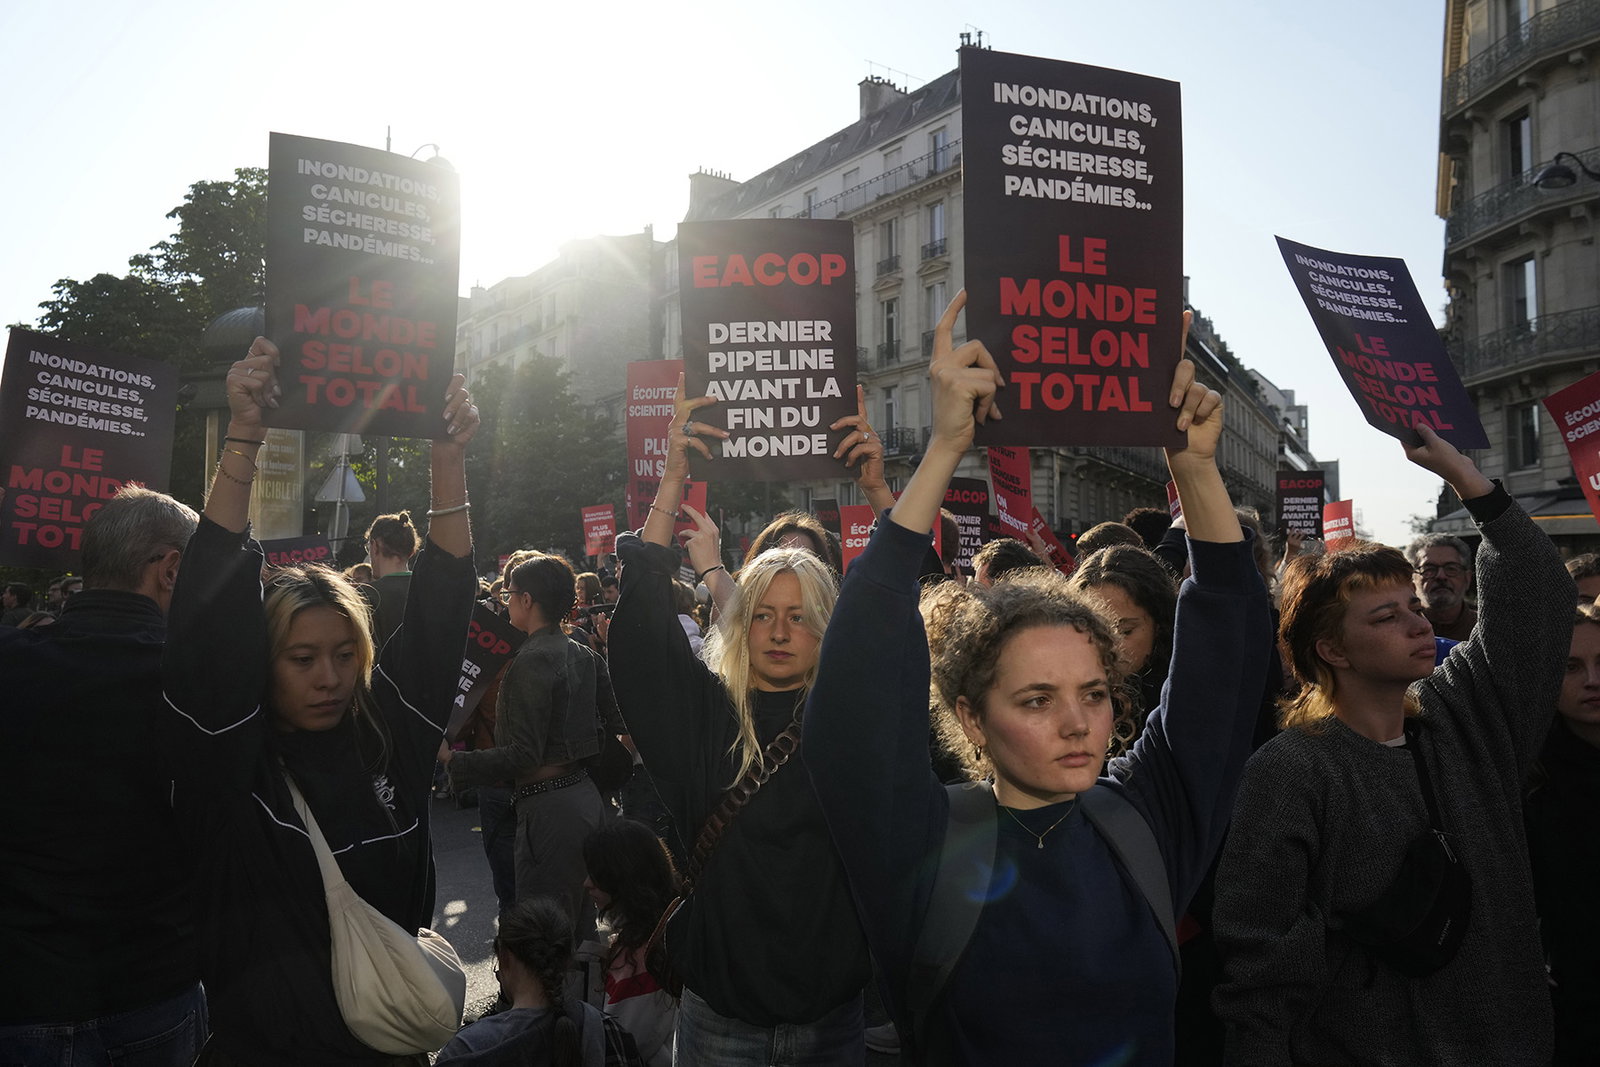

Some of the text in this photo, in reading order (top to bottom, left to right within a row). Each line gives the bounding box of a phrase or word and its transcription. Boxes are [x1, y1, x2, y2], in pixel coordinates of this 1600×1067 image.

[994, 82, 1157, 127] INONDATIONS,
[1009, 115, 1146, 154] CANICULES,
[1002, 140, 1154, 185] SÉCHERESSE,
[298, 159, 440, 204] INONDATIONS,
[1005, 175, 1152, 210] PANDÉMIES...
[311, 184, 431, 222] CANICULES,
[302, 203, 436, 245] SÉCHERESSE,
[304, 228, 433, 264] PANDÉMIES...
[1059, 234, 1107, 276] LE
[693, 252, 846, 288] EACOP
[1295, 253, 1394, 282] INONDATIONS,
[1308, 271, 1391, 296] CANICULES,
[348, 276, 394, 309] LE
[1000, 277, 1157, 325] MONDE
[1310, 283, 1403, 310] SÉCHERESSE,
[294, 303, 437, 348] MONDE
[1317, 298, 1407, 323] PANDÉMIES...
[709, 320, 832, 344] DERNIER
[1011, 324, 1149, 368] SELON
[1355, 332, 1391, 357] LE
[29, 350, 156, 390] INONDATIONS,
[301, 340, 429, 380] SELON
[708, 349, 835, 373] PIPELINE
[1336, 345, 1439, 382] MONDE
[28, 386, 148, 422] SÉCHERESSE,
[37, 371, 144, 405] CANICULES,
[299, 375, 426, 413] TOTAL
[705, 377, 842, 401] AVANT LA
[1011, 372, 1152, 412] TOTAL
[1353, 372, 1443, 406] SELON
[26, 405, 145, 437] PANDÉMIES...
[629, 405, 675, 416] SCIENTIFI
[727, 406, 820, 429] FIN DU
[1364, 395, 1454, 431] TOTAL
[1565, 400, 1600, 427] ÉCOU
[60, 445, 104, 471] LE
[644, 438, 669, 455] PLU
[722, 434, 827, 458] MONDE
[635, 460, 653, 476] UN
[1280, 480, 1323, 489] EACOP
[945, 488, 988, 504] EACOP
[12, 522, 84, 550] TOT
[952, 514, 981, 525] ERNIER
[268, 545, 329, 565] EACOP
[962, 548, 975, 557] DU
[970, 537, 982, 547] LA
[468, 620, 512, 655] COP
